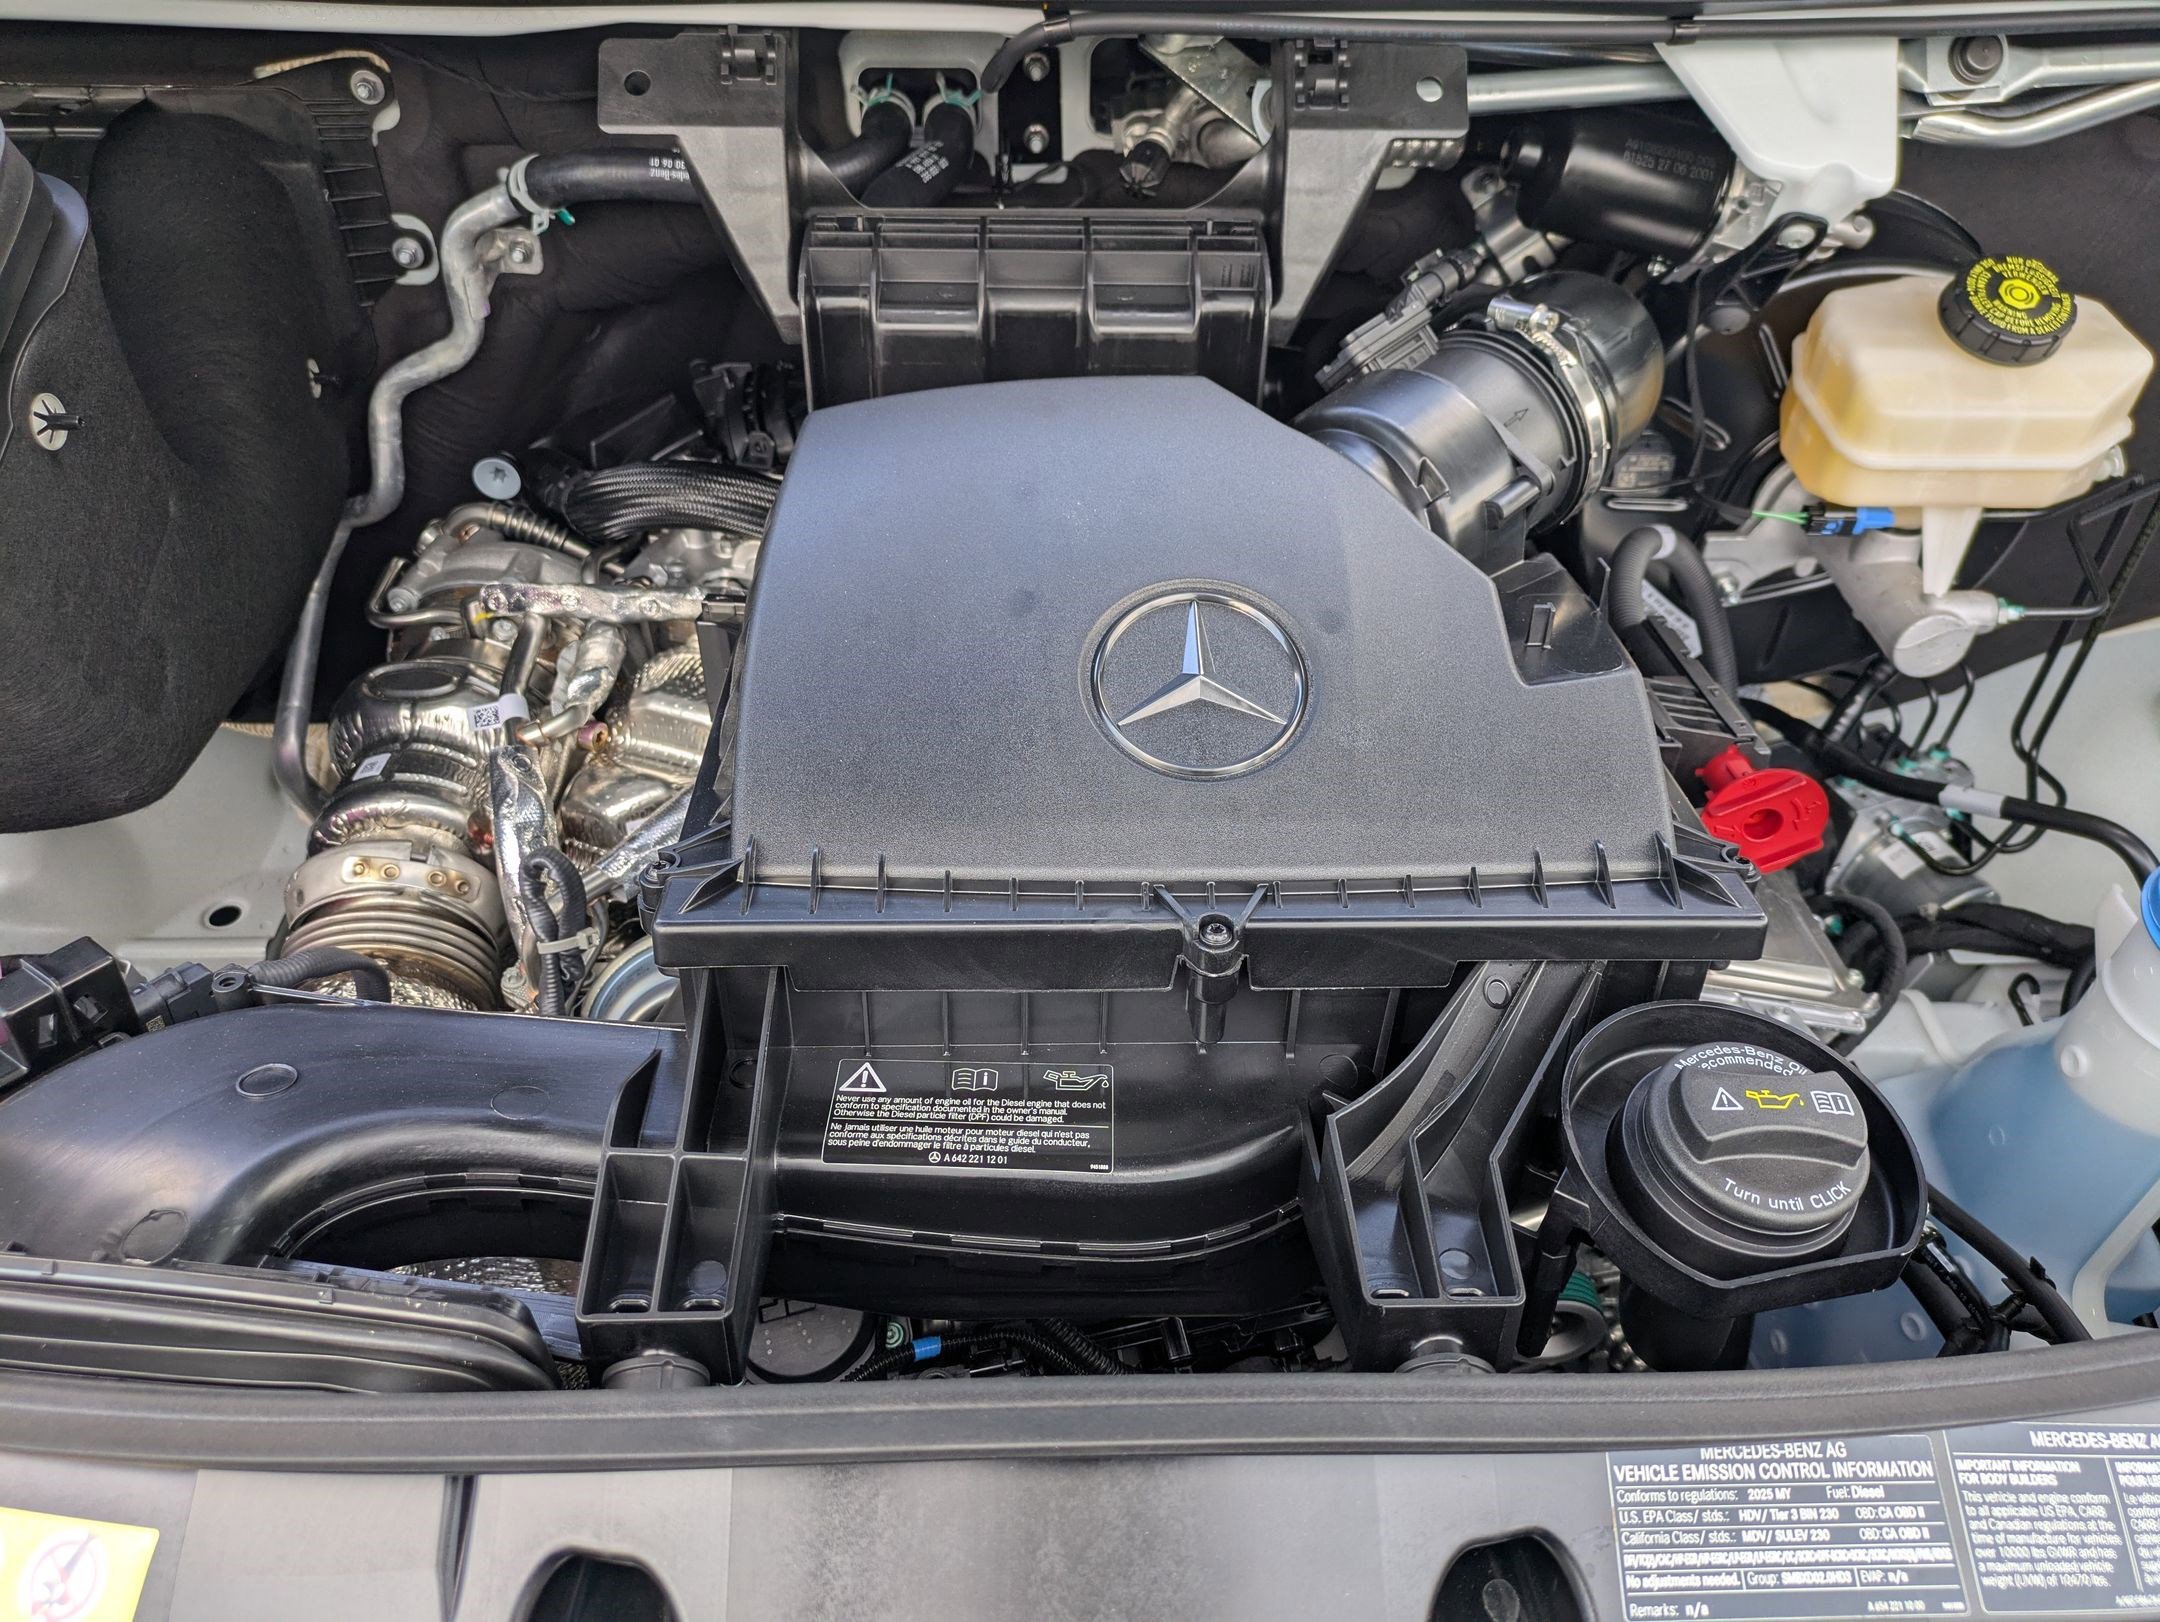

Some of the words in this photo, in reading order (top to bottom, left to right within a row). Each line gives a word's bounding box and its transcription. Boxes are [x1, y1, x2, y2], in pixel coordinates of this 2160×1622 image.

[650, 168, 690, 182] edes-Benz
[1674, 1045, 1783, 1070] Mercedes-Benz
[1789, 1061, 1808, 1075] Oil
[1698, 1055, 1793, 1076] ecommended
[835, 1101, 869, 1110] conform
[881, 1103, 931, 1112] specification
[933, 1105, 982, 1113] documented
[992, 1106, 1004, 1114] the
[1006, 1107, 1037, 1115] owner's
[878, 1096, 892, 1104] any
[924, 1097, 934, 1105] of
[935, 1098, 960, 1106] engine
[973, 1098, 985, 1106] for
[1001, 1099, 1025, 1107] Diesel
[1026, 1099, 1052, 1108] engine
[1054, 1100, 1070, 1108] that
[1093, 1101, 1106, 1109] not
[834, 1108, 875, 1118] Otherwise
[877, 1110, 889, 1118] the
[891, 1110, 916, 1118] Diesel
[916, 1111, 946, 1120] particle
[948, 1111, 966, 1120] filter
[968, 1113, 990, 1122] (DPF)
[991, 1113, 1012, 1121] could
[1014, 1114, 1024, 1122] be
[1025, 1115, 1064, 1124] damaged.
[829, 1131, 869, 1139] conforme
[978, 1135, 998, 1143] dans
[999, 1136, 1006, 1144] le
[1008, 1137, 1029, 1146] guide
[1043, 1138, 1091, 1148] conducteur,
[843, 1123, 870, 1132] jamais
[871, 1124, 898, 1132] utiliser
[915, 1125, 933, 1133] huile
[934, 1127, 964, 1135] moteur
[965, 1128, 984, 1136] pour
[1017, 1129, 1040, 1137] diesel
[1041, 1130, 1053, 1138] qui
[1054, 1130, 1074, 1139] n'est
[848, 1139, 870, 1148] peine
[872, 1139, 931, 1150] d'endommager
[933, 1141, 941, 1149] le
[942, 1141, 961, 1150] filtre
[970, 1143, 1010, 1152] particules
[943, 1154, 951, 1162] A
[951, 1153, 967, 1163] 642
[968, 1154, 983, 1163] 221
[987, 1155, 996, 1164] 12
[997, 1155, 1008, 1164] 01
[1723, 1177, 1762, 1205] Turn
[1768, 1197, 1805, 1211] until
[1809, 1180, 1851, 1209] CLICK
[2029, 1431, 2150, 1449] MERCEDES-BENZ
[1700, 1442, 1824, 1460] MERCEDES-BENZ
[1826, 1441, 1847, 1459] AG
[1613, 1464, 1680, 1483] VEHICLE
[1682, 1463, 1756, 1481] EMISSION
[1758, 1461, 1830, 1480] CONTROL
[1832, 1460, 1934, 1479] INFORMATION
[1617, 1489, 1666, 1503] Conforms
[1668, 1490, 1678, 1502] to
[1681, 1488, 1738, 1504] regulations:
[1747, 1488, 1774, 1500] 2025
[1775, 1487, 1792, 1500] MY
[1826, 1485, 1850, 1499] Fuel:
[1851, 1485, 1885, 1499] Diesel
[1619, 1511, 1642, 1525] U.S.
[1643, 1510, 1664, 1524] EPA
[1769, 1508, 1789, 1521] Tier
[1791, 1508, 1798, 1521] 3
[1800, 1508, 1818, 1520] BIN
[1819, 1507, 1840, 1521] 230
[1621, 1531, 1671, 1545] California
[1625, 1575, 1641, 1589] No
[1629, 1603, 1680, 1618] Remarks:
[1685, 1602, 1709, 1619] n/a
